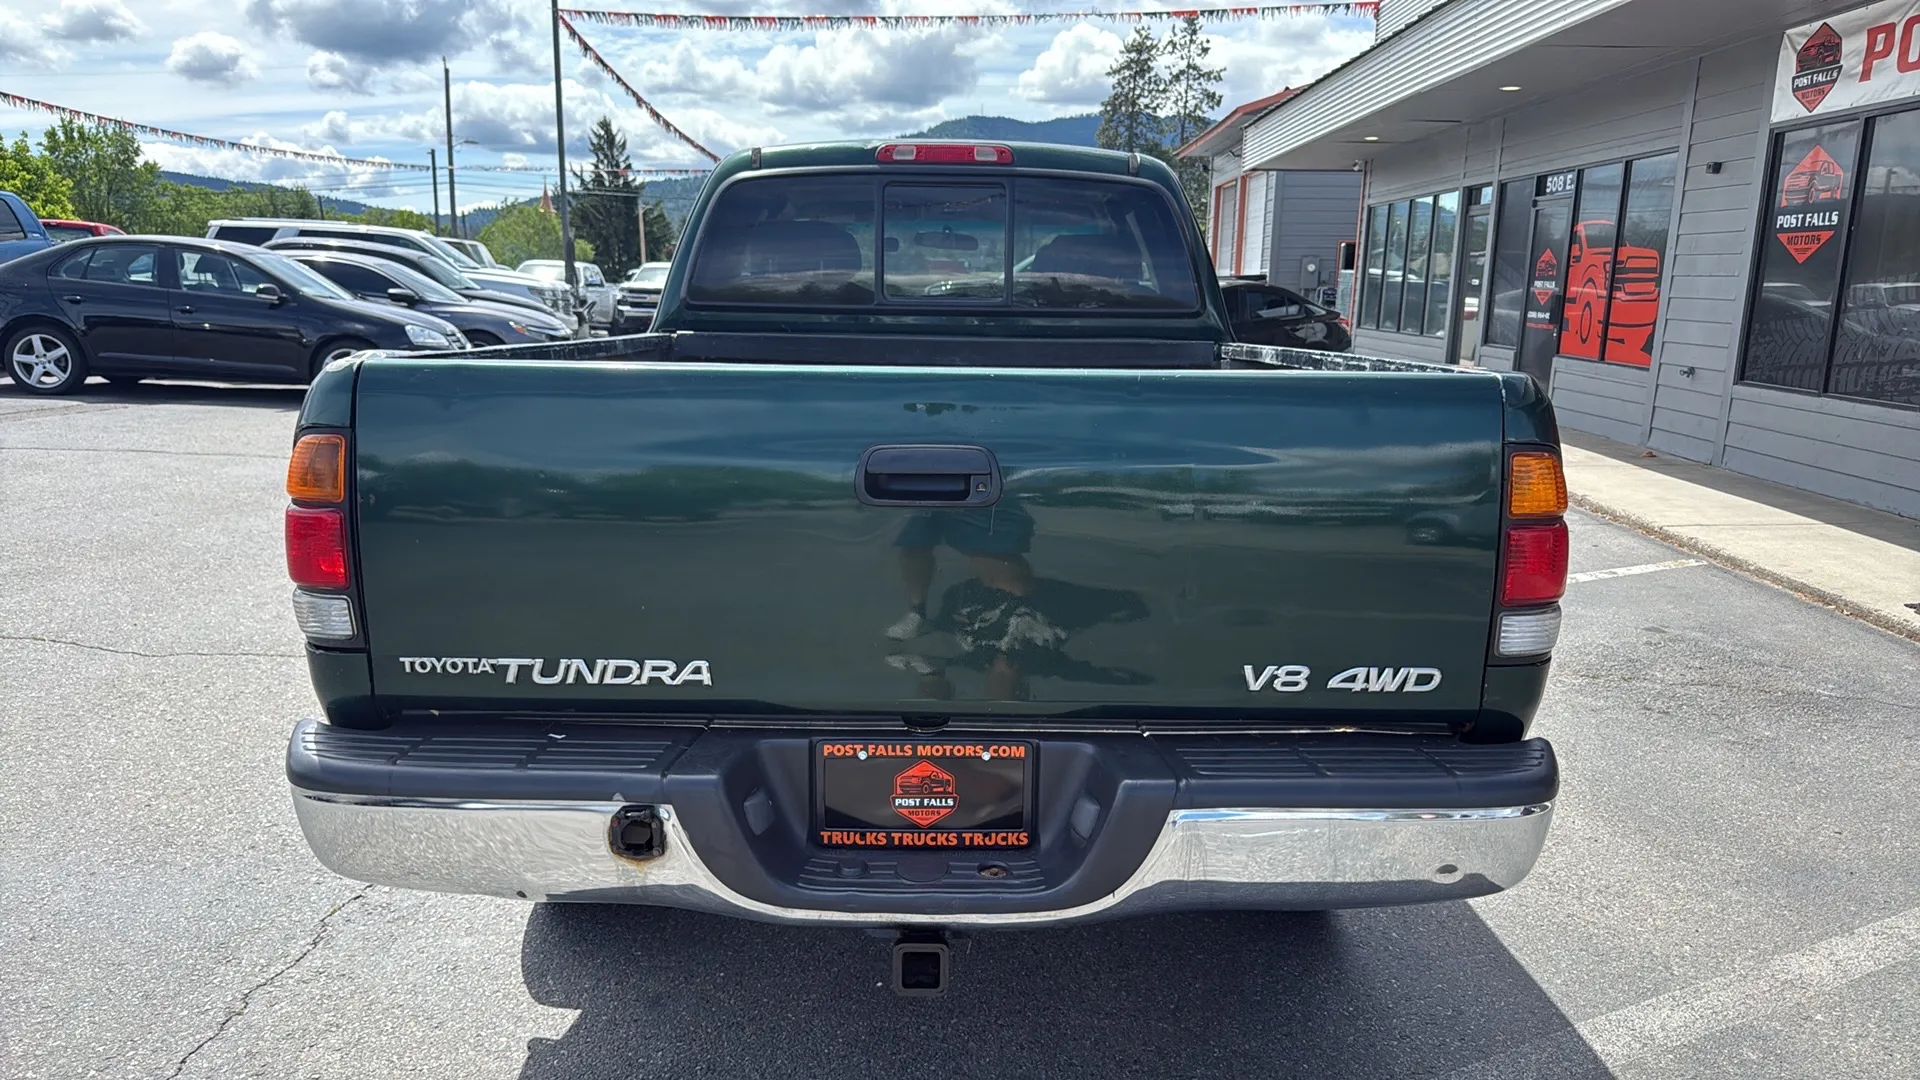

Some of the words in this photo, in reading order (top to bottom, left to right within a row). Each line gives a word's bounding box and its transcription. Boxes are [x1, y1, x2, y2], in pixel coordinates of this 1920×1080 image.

[1793, 75, 1812, 89] POST
[1813, 69, 1839, 84] FALLS
[1801, 87, 1825, 100] MOTORS
[1545, 175, 1563, 193] 508
[1565, 173, 1575, 190] E.
[1776, 213, 1802, 229] POST
[1804, 211, 1839, 227] FALLS
[1786, 234, 1822, 246] MOTORS
[399, 657, 495, 674] TOYOTA
[489, 658, 713, 686] TUNDRA
[1243, 664, 1311, 692] V8
[1326, 666, 1442, 692] 4WD
[823, 744, 864, 757] POST
[868, 744, 913, 756] FALLS
[916, 744, 1025, 758] MOTORSCOM
[895, 798, 921, 806] POST
[923, 798, 954, 806] FALLS
[820, 831, 887, 845] TRUCKS
[891, 832, 958, 846] TRUCKS
[962, 832, 1029, 846] TRUCKS
